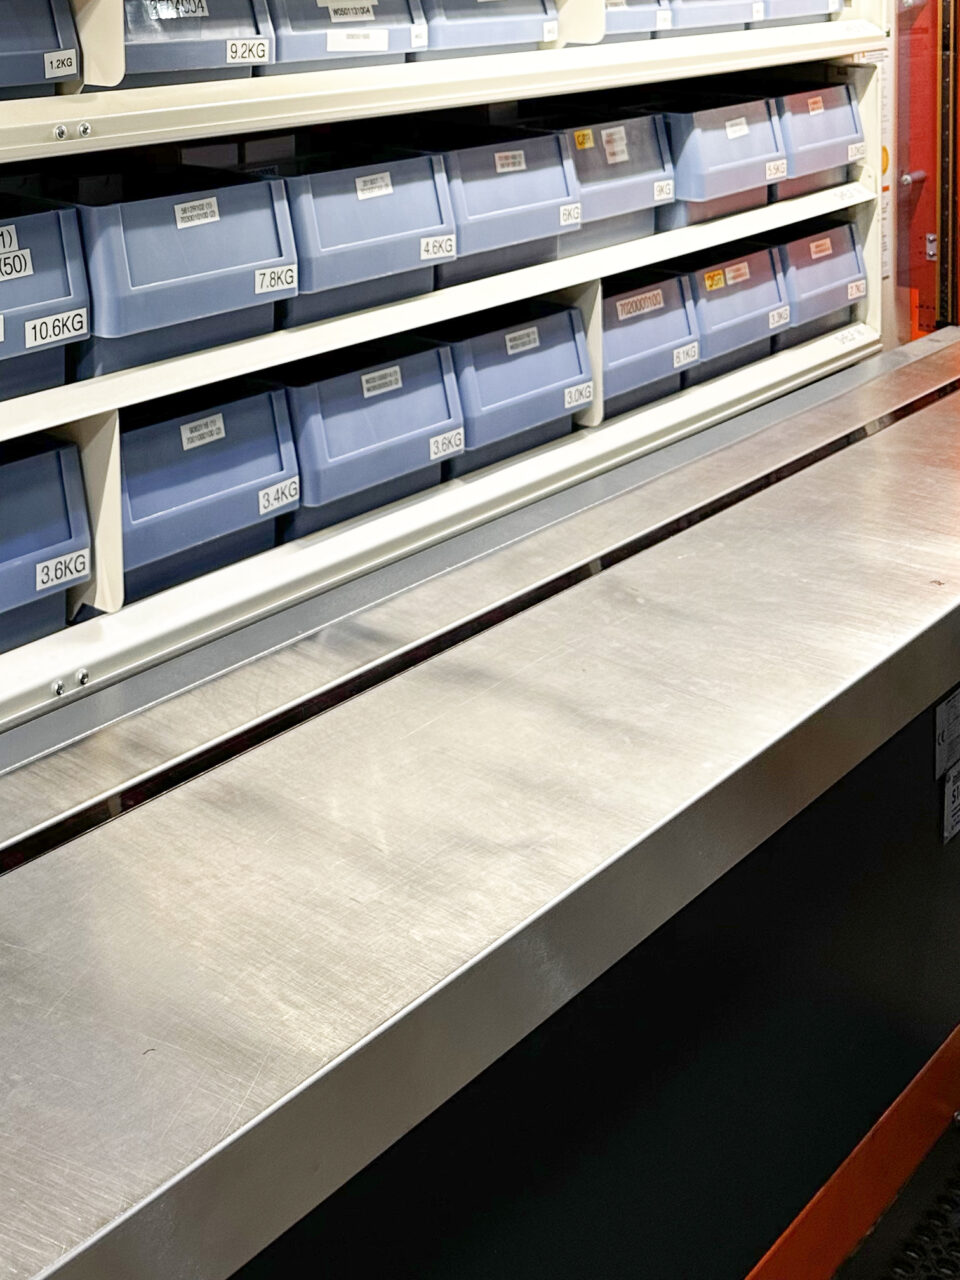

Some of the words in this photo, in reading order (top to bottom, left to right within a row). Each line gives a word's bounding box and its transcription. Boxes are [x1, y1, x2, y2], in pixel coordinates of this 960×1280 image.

[230, 42, 266, 60] 9.2KG
[49, 57, 73, 71] 1.2KG
[424, 237, 453, 257] 4.6KG
[259, 268, 295, 290] 7.8KG
[31, 313, 84, 342] 10.6KG
[433, 431, 462, 456] 3.6KG
[262, 480, 298, 510] 3.4KG
[41, 554, 86, 585] 3.6KG
